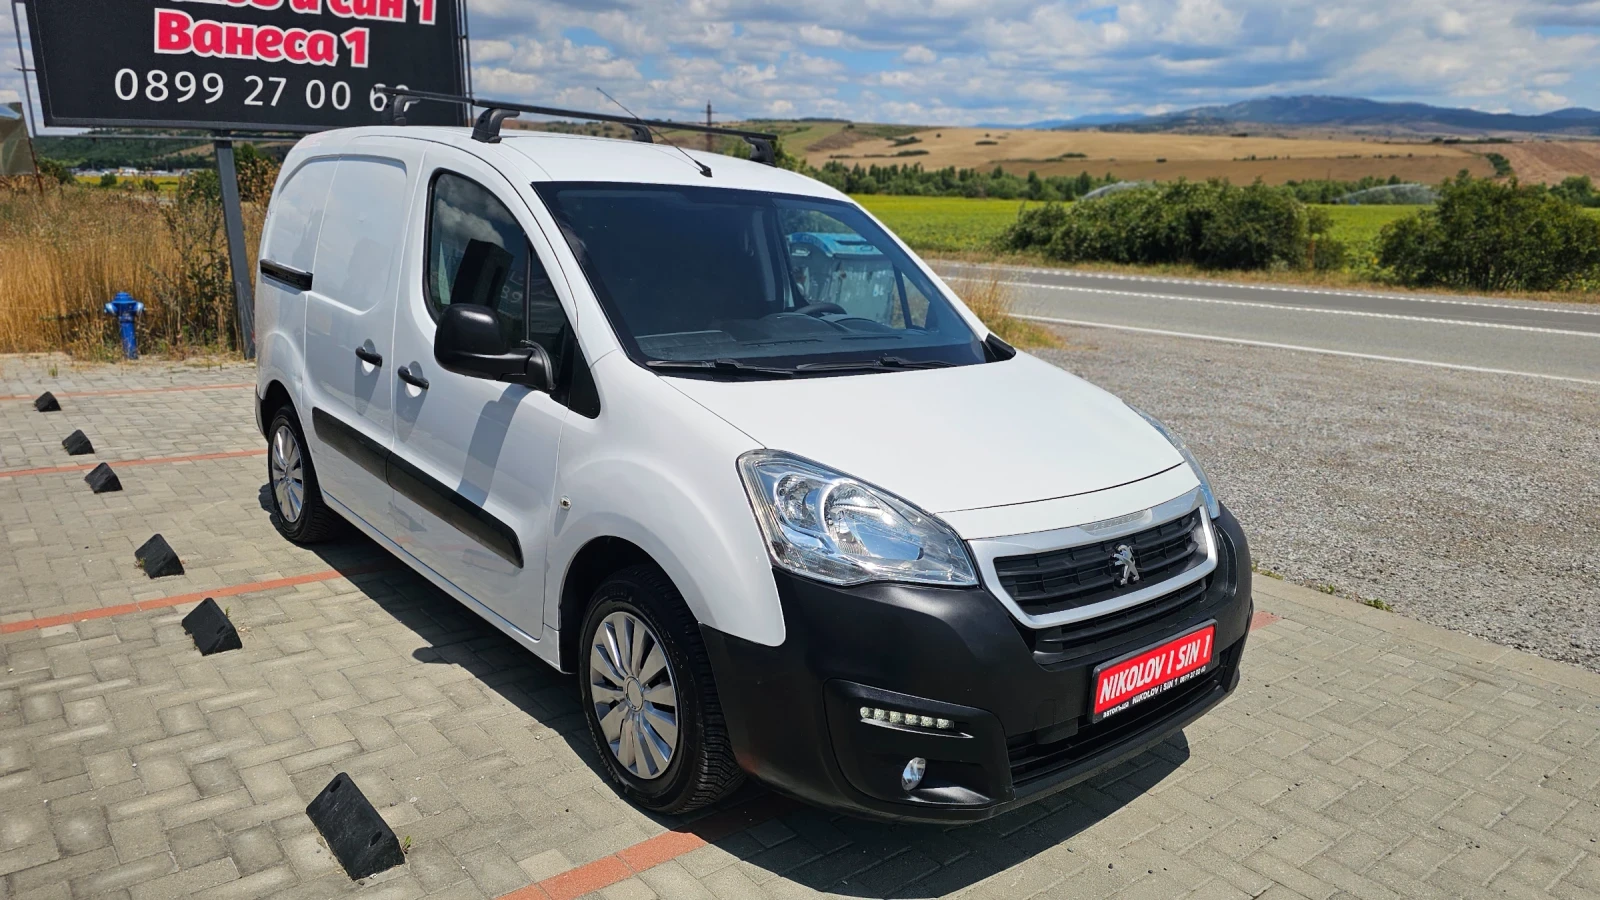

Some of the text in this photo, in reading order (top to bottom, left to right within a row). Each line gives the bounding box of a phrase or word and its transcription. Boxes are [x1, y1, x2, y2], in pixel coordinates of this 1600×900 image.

[154, 7, 369, 68] Ванеса 1
[114, 67, 225, 104] 0899
[244, 74, 287, 107] 27
[305, 79, 351, 111] 00
[1099, 653, 1166, 704] NIKOLOV
[1176, 639, 1201, 671] SIN
[1132, 685, 1160, 704] NIKOLOV
